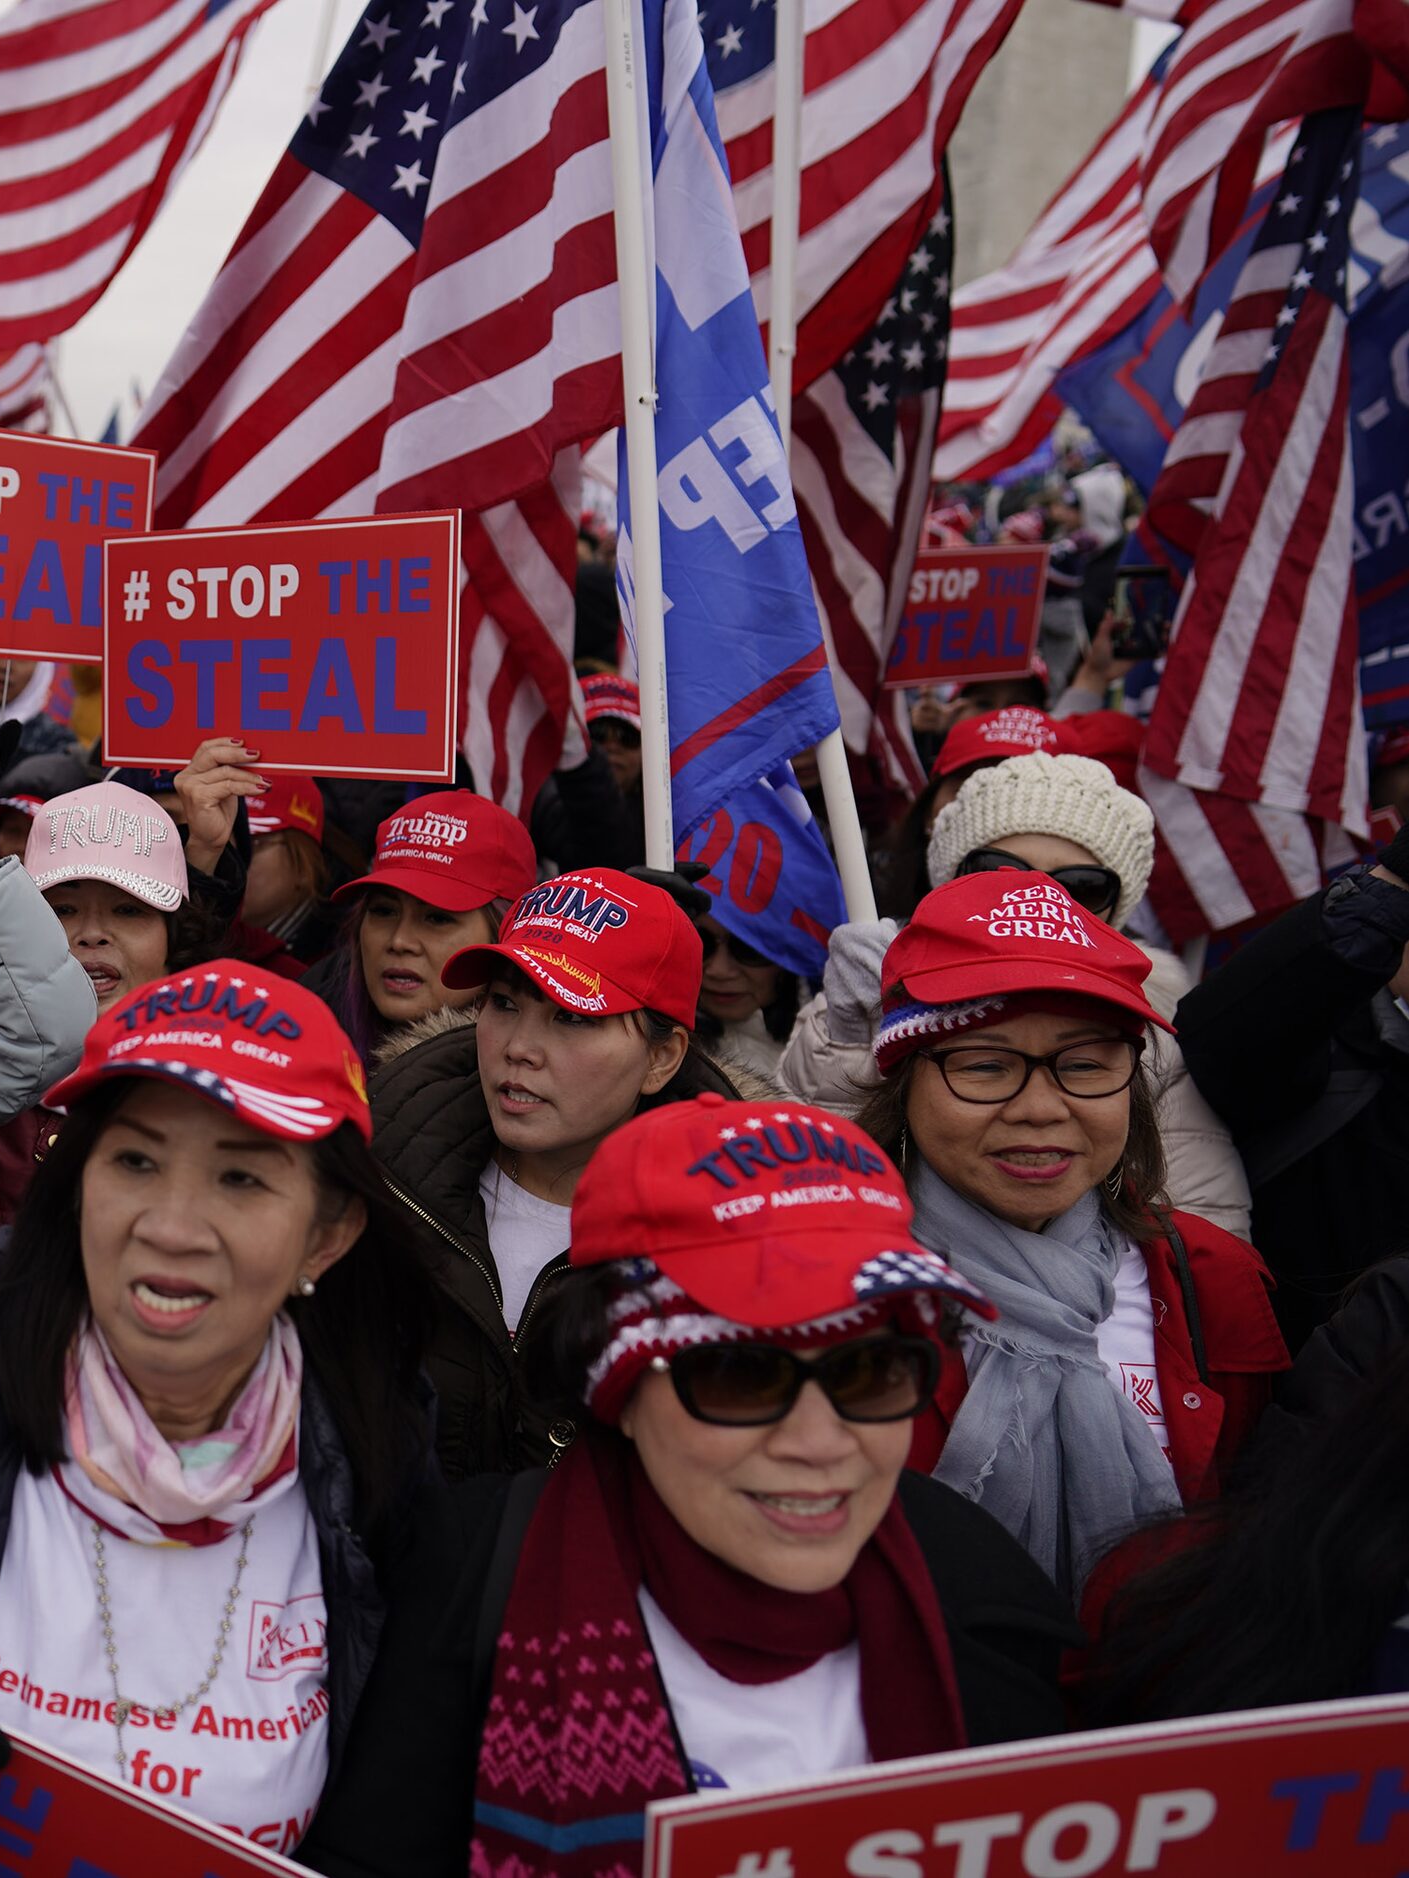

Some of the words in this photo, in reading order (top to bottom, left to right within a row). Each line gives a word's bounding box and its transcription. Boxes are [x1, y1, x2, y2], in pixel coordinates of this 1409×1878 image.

[38, 472, 135, 529] THE
[124, 570, 150, 621] #
[166, 564, 299, 619] STOP
[319, 557, 431, 615] THE
[909, 567, 980, 603] STOP
[988, 566, 1036, 596] THE
[125, 637, 427, 734] STEAL
[999, 708, 1044, 724] KEEP
[985, 730, 1044, 747] GREAT
[45, 804, 168, 858] TRUMP
[386, 816, 467, 847] Trump
[424, 811, 468, 828] President
[391, 849, 425, 859] AMERICA
[426, 851, 453, 864] GREAT
[408, 834, 441, 847] 2020
[513, 885, 629, 935] TRUMP
[528, 917, 562, 930] AMERICA
[522, 928, 563, 944] 2020
[115, 981, 302, 1040] TRUMP
[547, 974, 608, 1012] PRESIDENT
[107, 1035, 144, 1059] KEEP
[144, 1031, 223, 1049] AMERICA
[231, 1039, 292, 1067] GREAT
[687, 1122, 887, 1188] TRUMP
[712, 1194, 766, 1223] KEEP
[771, 1185, 856, 1208] AMERICA
[132, 1749, 202, 1798] for
